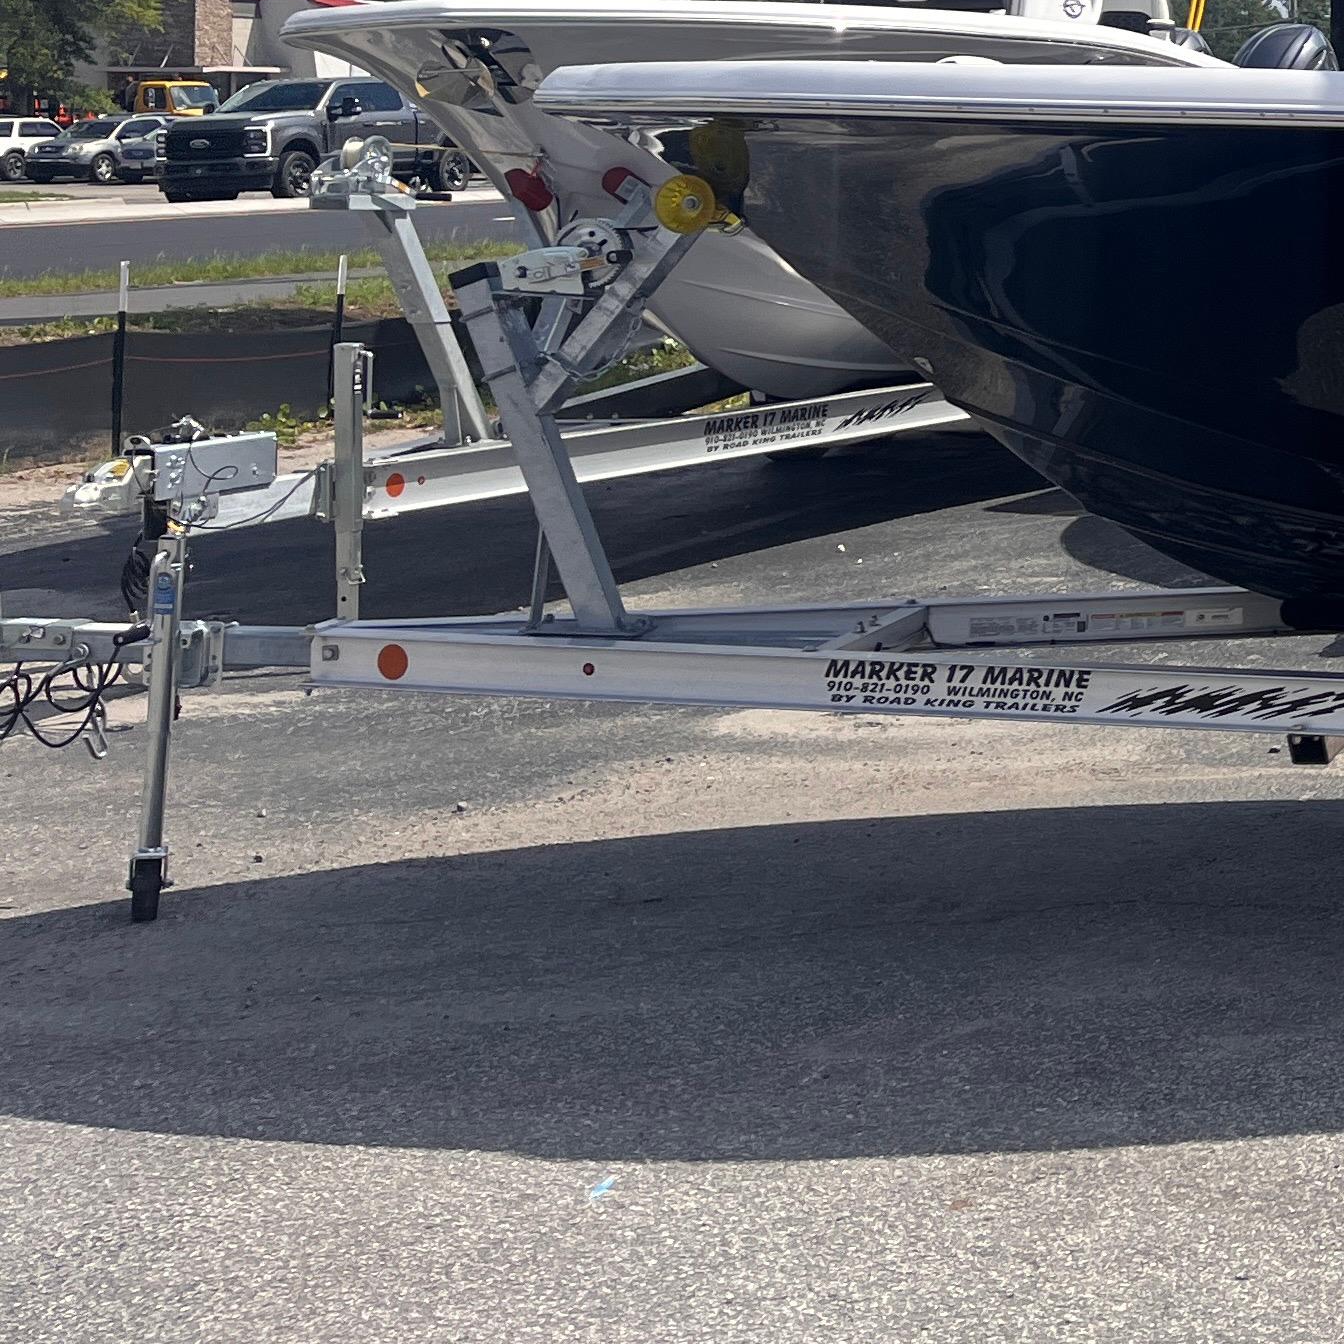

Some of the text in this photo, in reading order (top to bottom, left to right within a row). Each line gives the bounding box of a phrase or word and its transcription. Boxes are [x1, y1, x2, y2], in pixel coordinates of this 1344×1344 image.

[704, 404, 829, 436] MARKER 17 MARINE
[722, 440, 749, 450] ROAD
[752, 437, 776, 445] KING
[824, 659, 1091, 689] MARKER 17 MARINE
[827, 680, 1084, 702] 910-821-0190 WILMINGTON, NC
[830, 693, 1080, 714] BY ROAD KING TRAILERS
